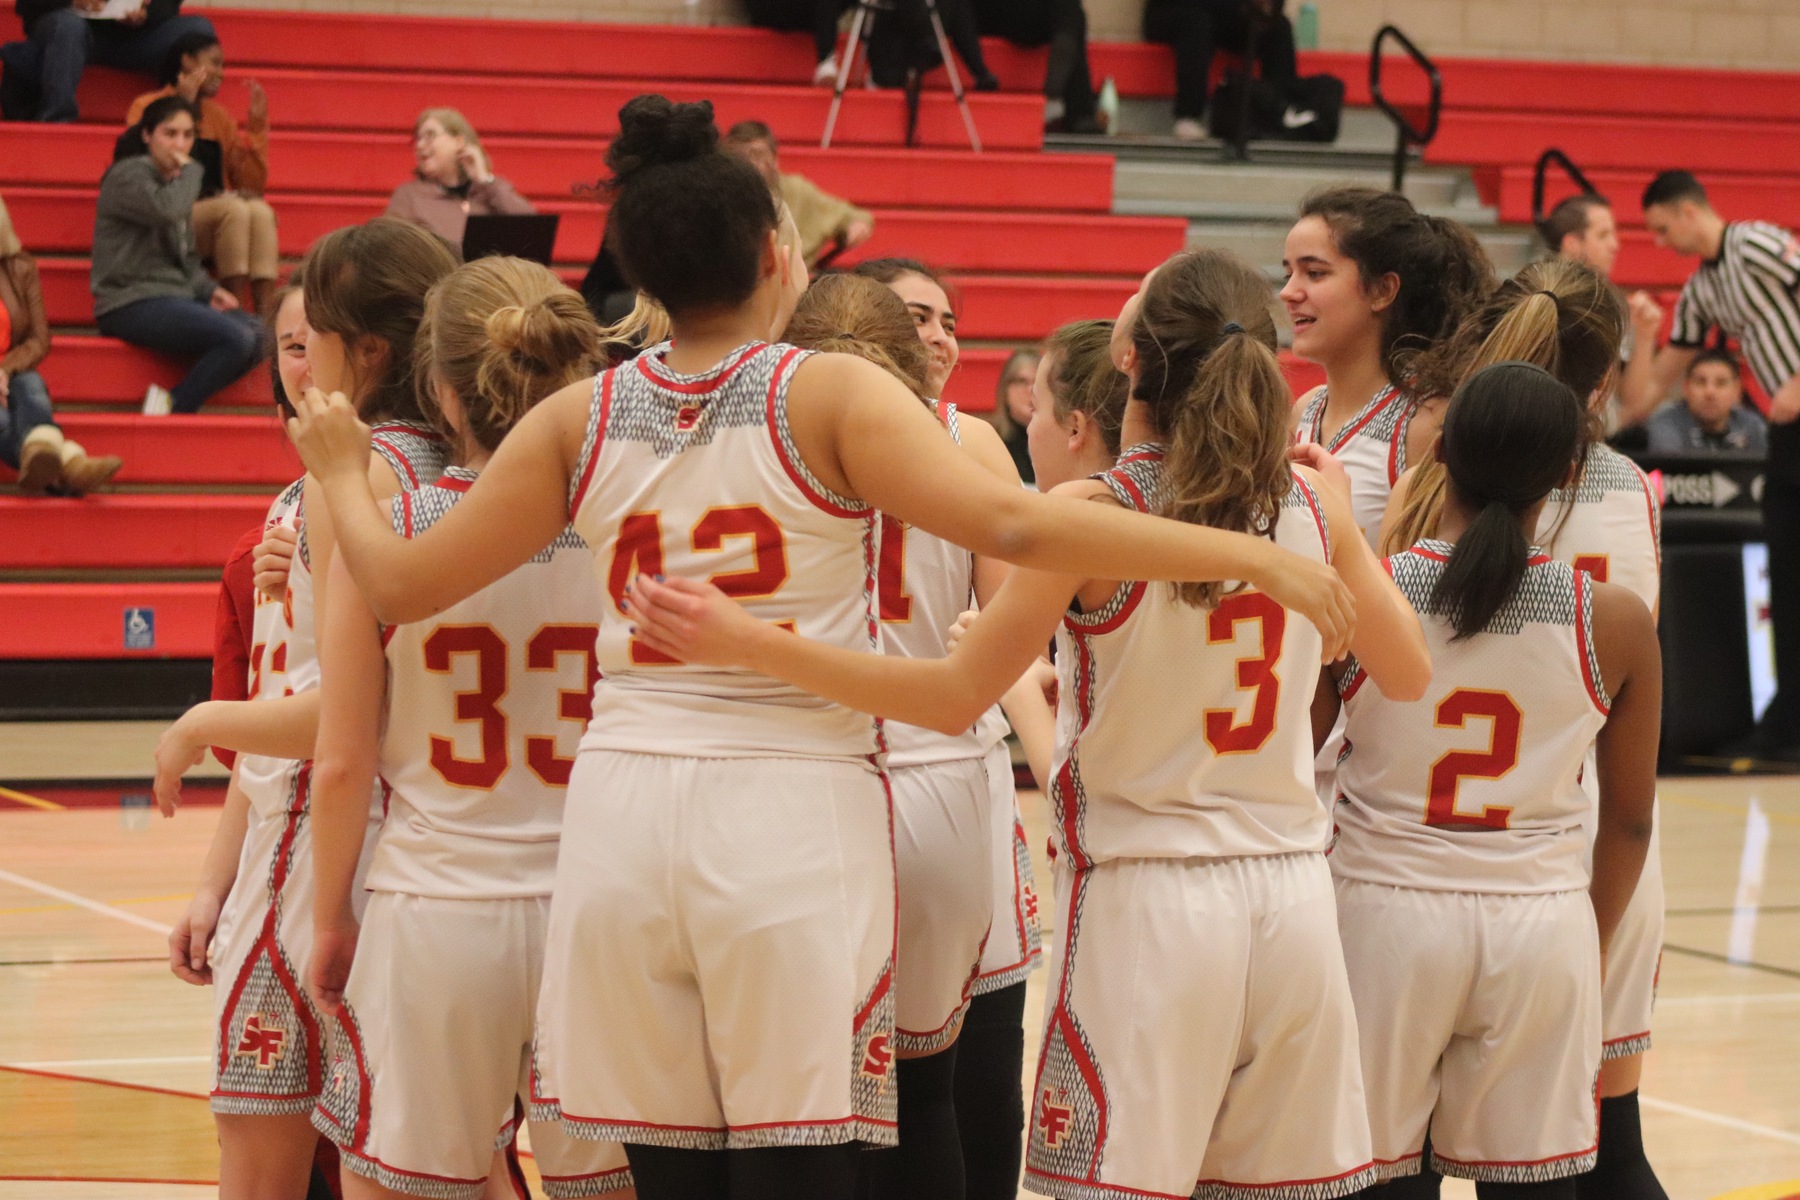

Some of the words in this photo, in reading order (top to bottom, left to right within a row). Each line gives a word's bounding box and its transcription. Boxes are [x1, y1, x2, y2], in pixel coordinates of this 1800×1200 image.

[422, 622, 603, 791] 33
[1203, 589, 1287, 758] 3
[1423, 686, 1525, 829] 2
[235, 1012, 287, 1069] SF
